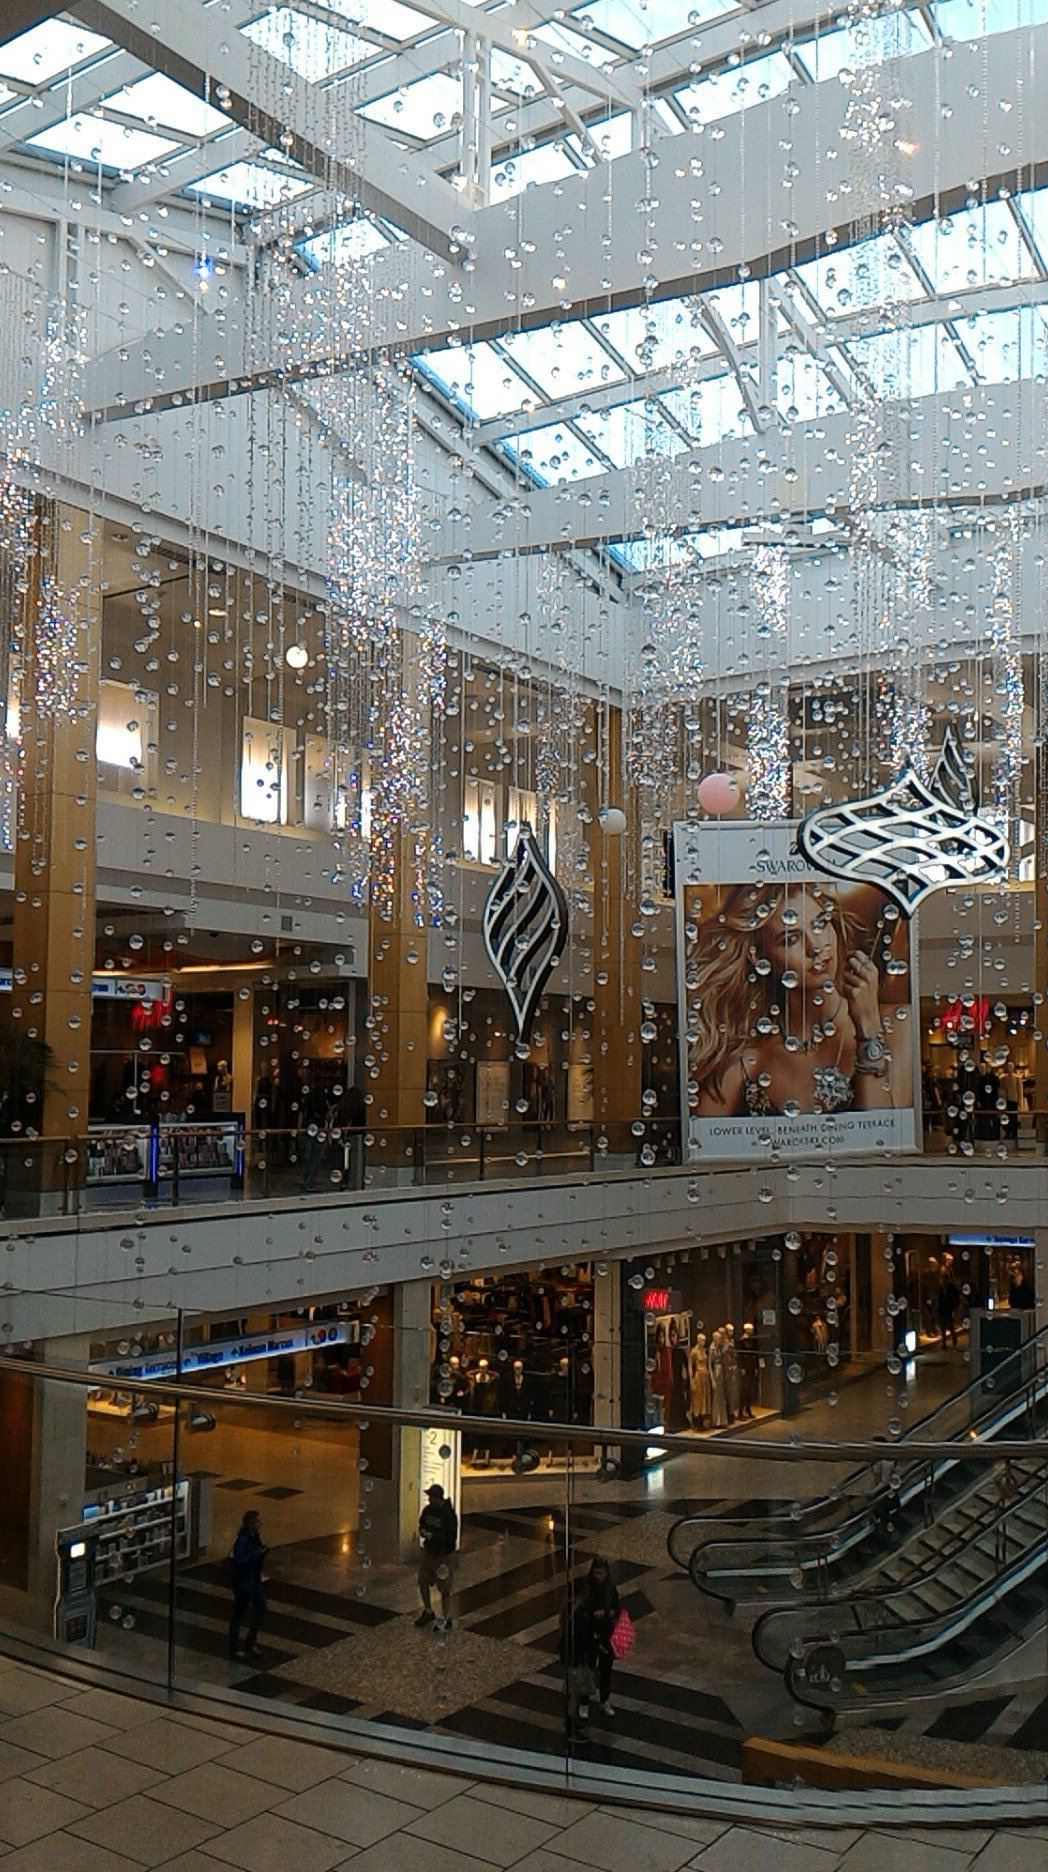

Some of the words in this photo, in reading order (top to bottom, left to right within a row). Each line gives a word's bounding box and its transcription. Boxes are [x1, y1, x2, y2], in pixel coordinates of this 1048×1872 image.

[709, 1126, 742, 1137] LOWER
[777, 1123, 817, 1135] BENEATH
[858, 1118, 896, 1130] TERRACE
